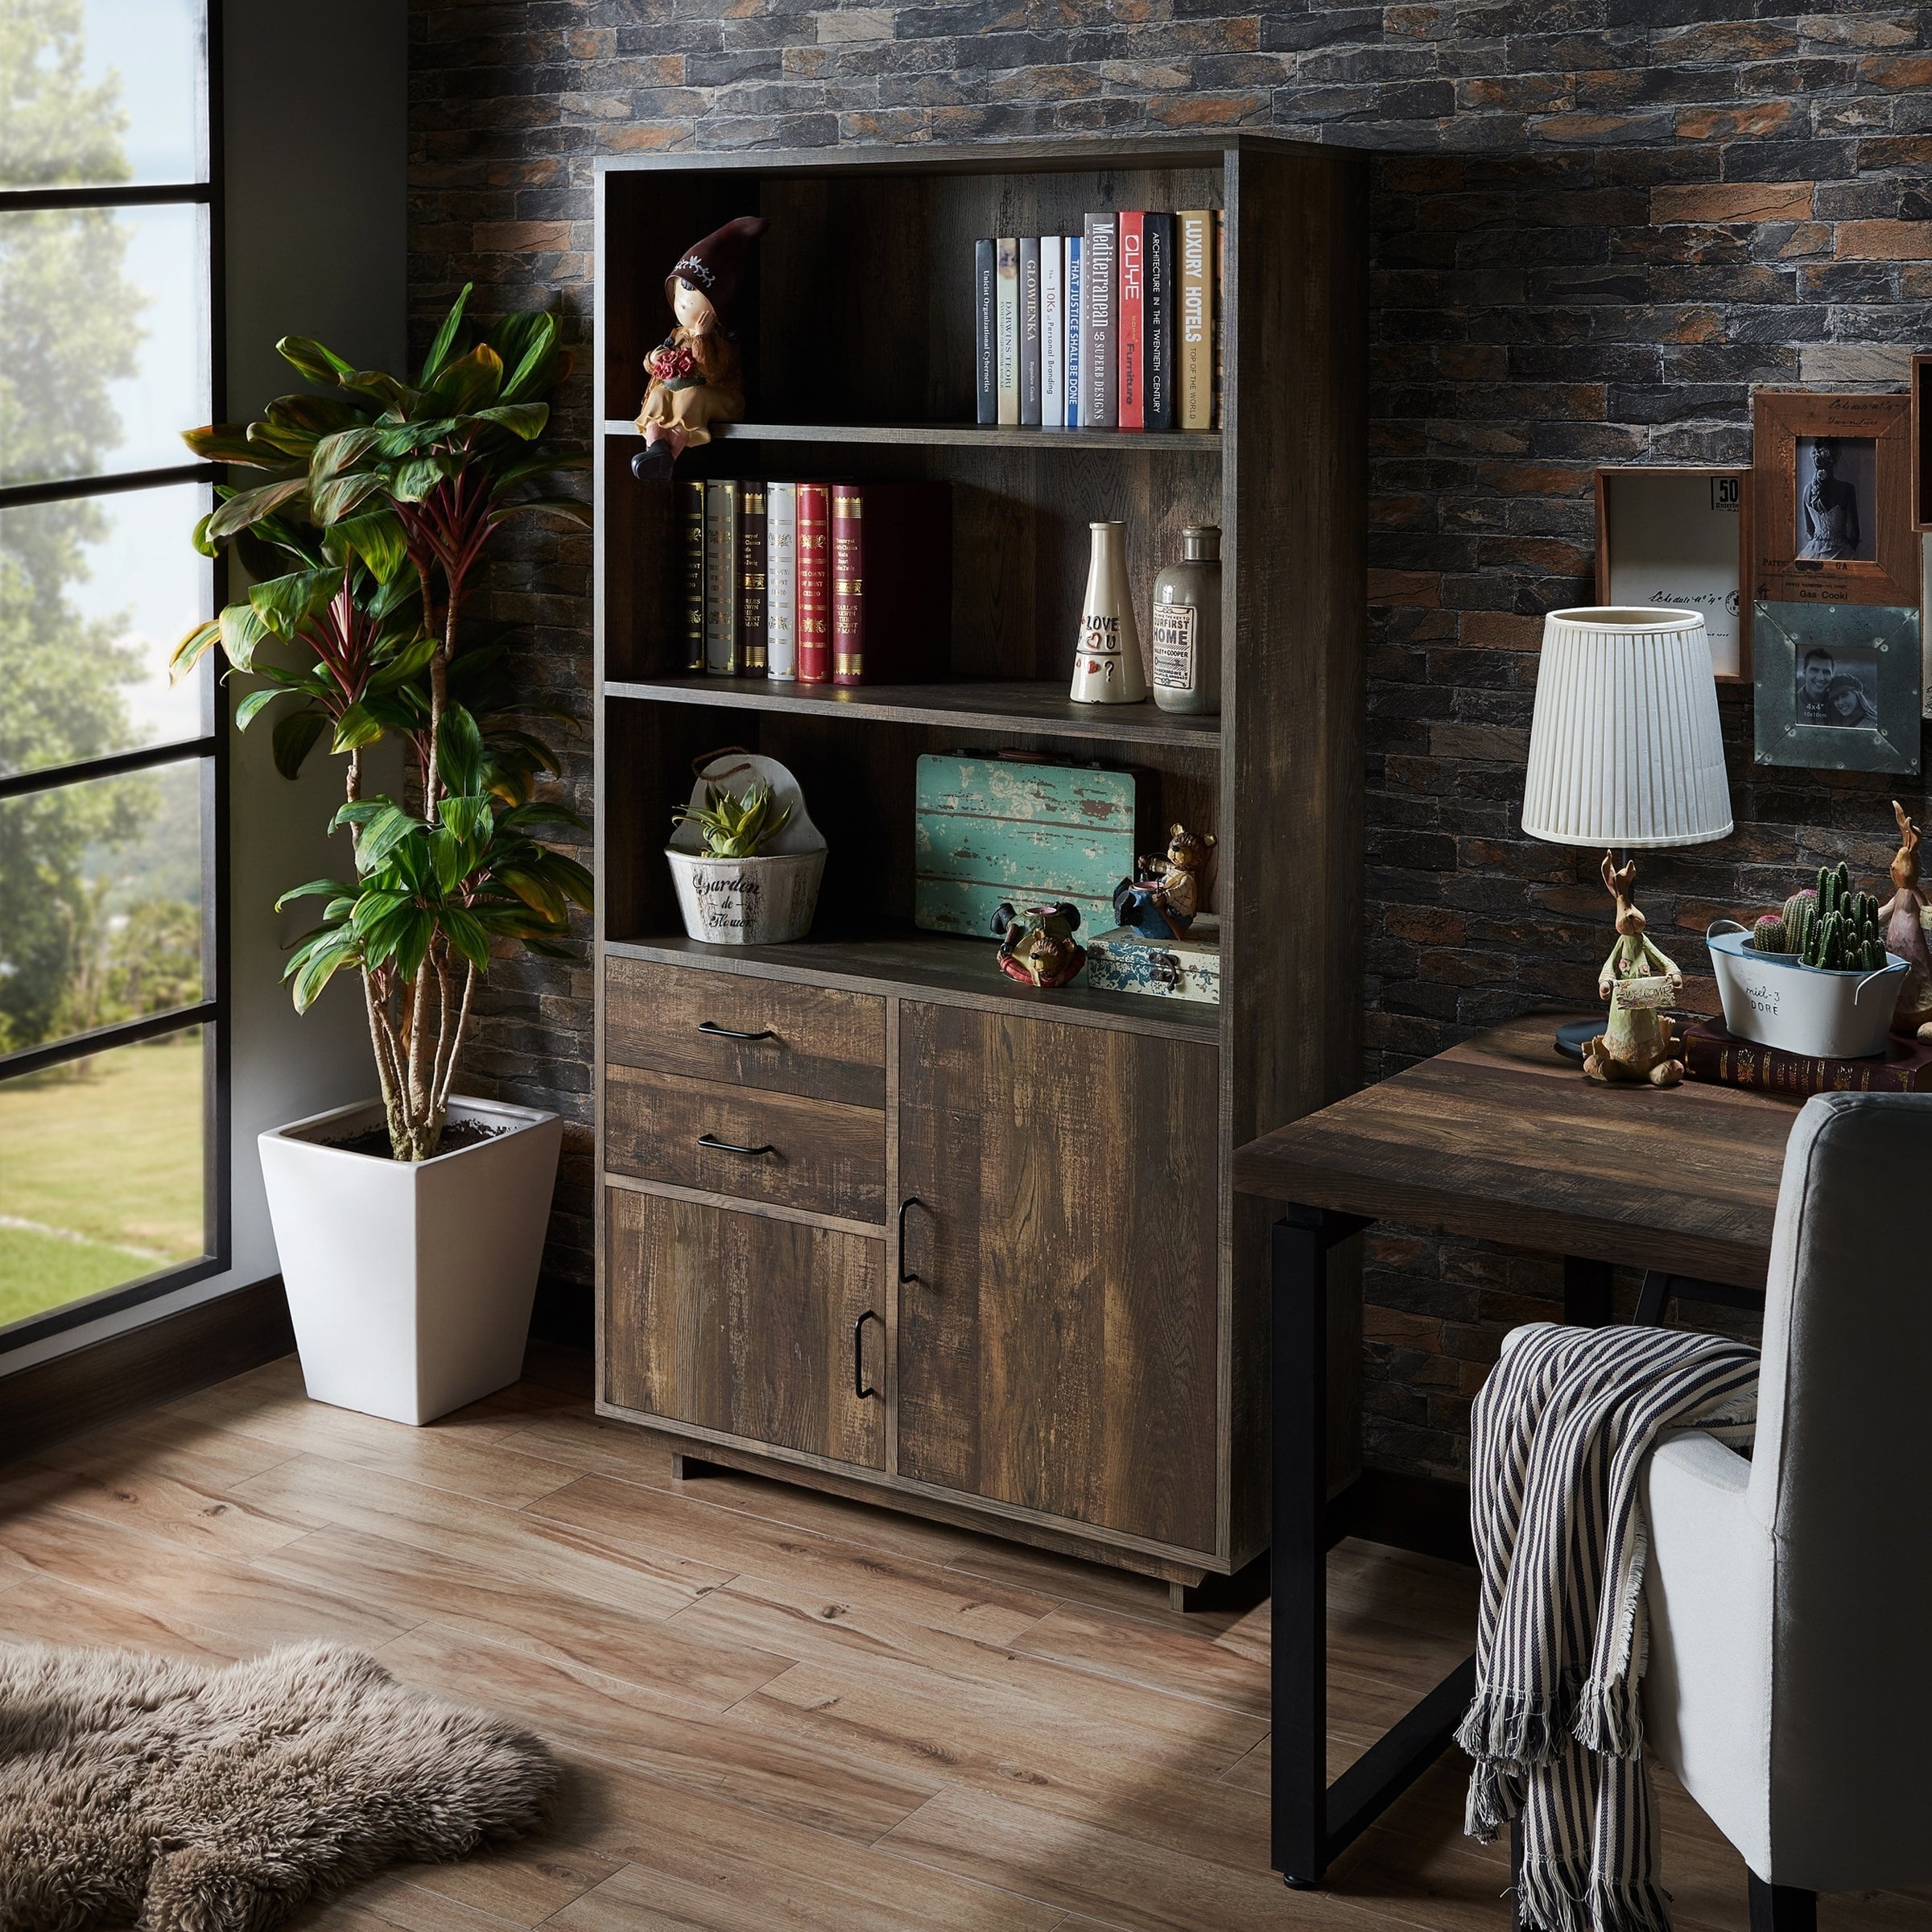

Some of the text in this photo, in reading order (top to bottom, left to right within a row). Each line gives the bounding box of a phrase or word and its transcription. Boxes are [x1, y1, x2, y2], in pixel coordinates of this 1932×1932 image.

[1092, 224, 1113, 327] Mediterranean
[1185, 221, 1201, 342] LUXURY HOTELS
[1027, 260, 1035, 341] GŁOWIENKA
[1046, 287, 1055, 312] 10Ks
[1153, 297, 1160, 305] IN
[1069, 259, 1080, 404] THAT JUSTICE SHALL BE DONE
[1094, 332, 1104, 341] 65
[1046, 361, 1055, 394] Branding
[1126, 344, 1134, 405] Furniture
[1190, 364, 1196, 374] OF
[1094, 344, 1104, 419] SUPERB DESIGNS
[1719, 479, 1739, 502] 50
[1799, 590, 1847, 600] Gas Cooki
[1086, 616, 1120, 631] LOVE
[1154, 626, 1187, 646] HOME
[693, 871, 760, 895] Garden
[721, 896, 733, 910] de
